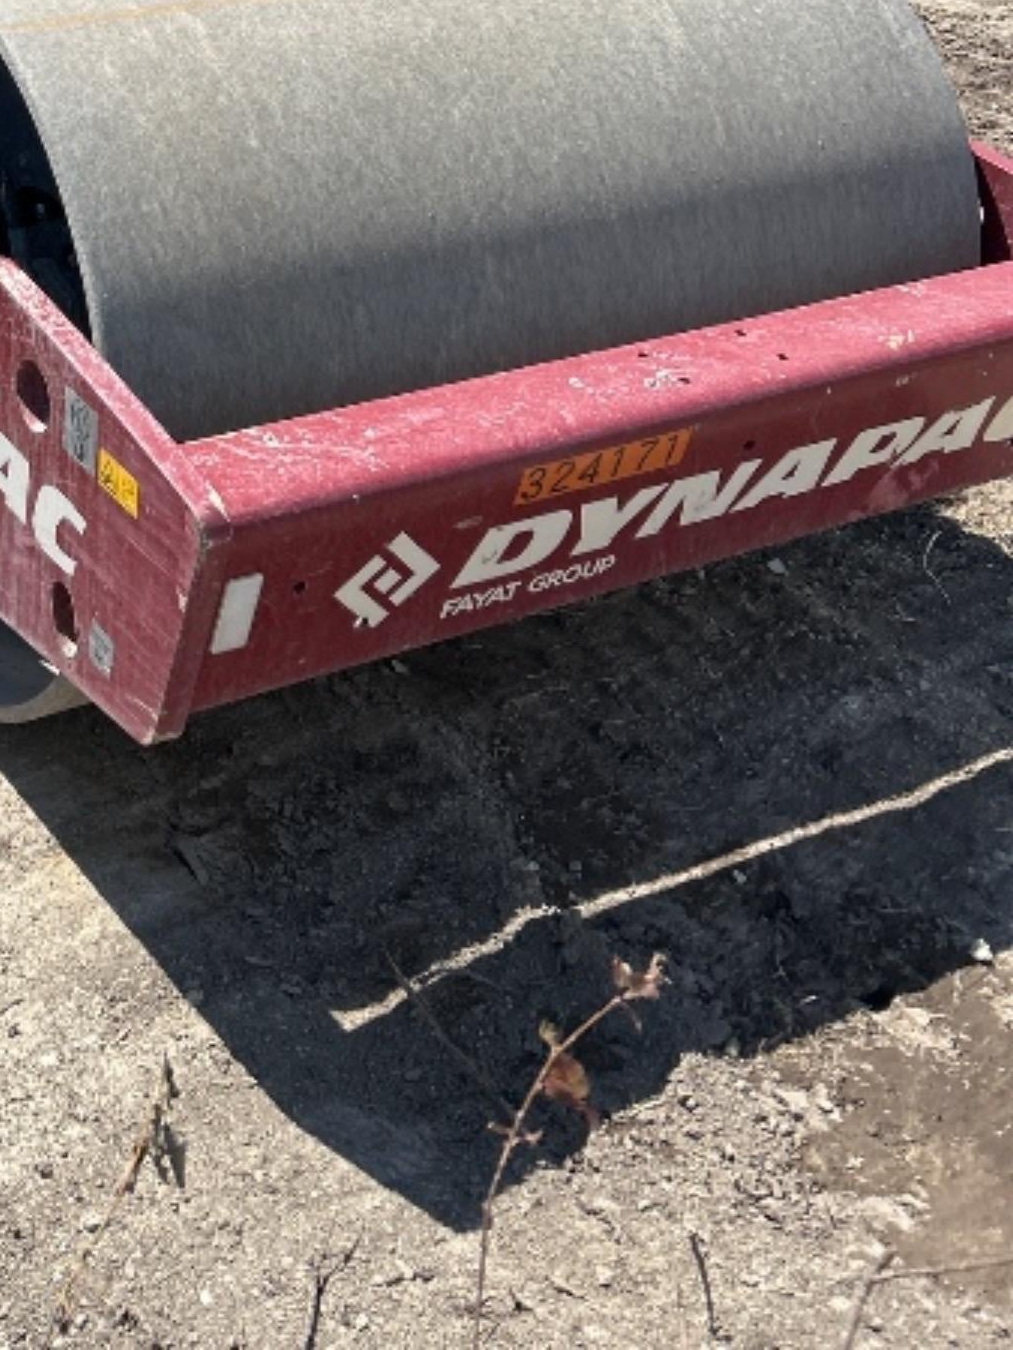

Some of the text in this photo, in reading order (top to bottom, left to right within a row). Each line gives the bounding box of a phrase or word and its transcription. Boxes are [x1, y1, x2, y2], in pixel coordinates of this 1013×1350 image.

[520, 434, 678, 499] 324171
[439, 554, 617, 619] FAYAT GROUP
